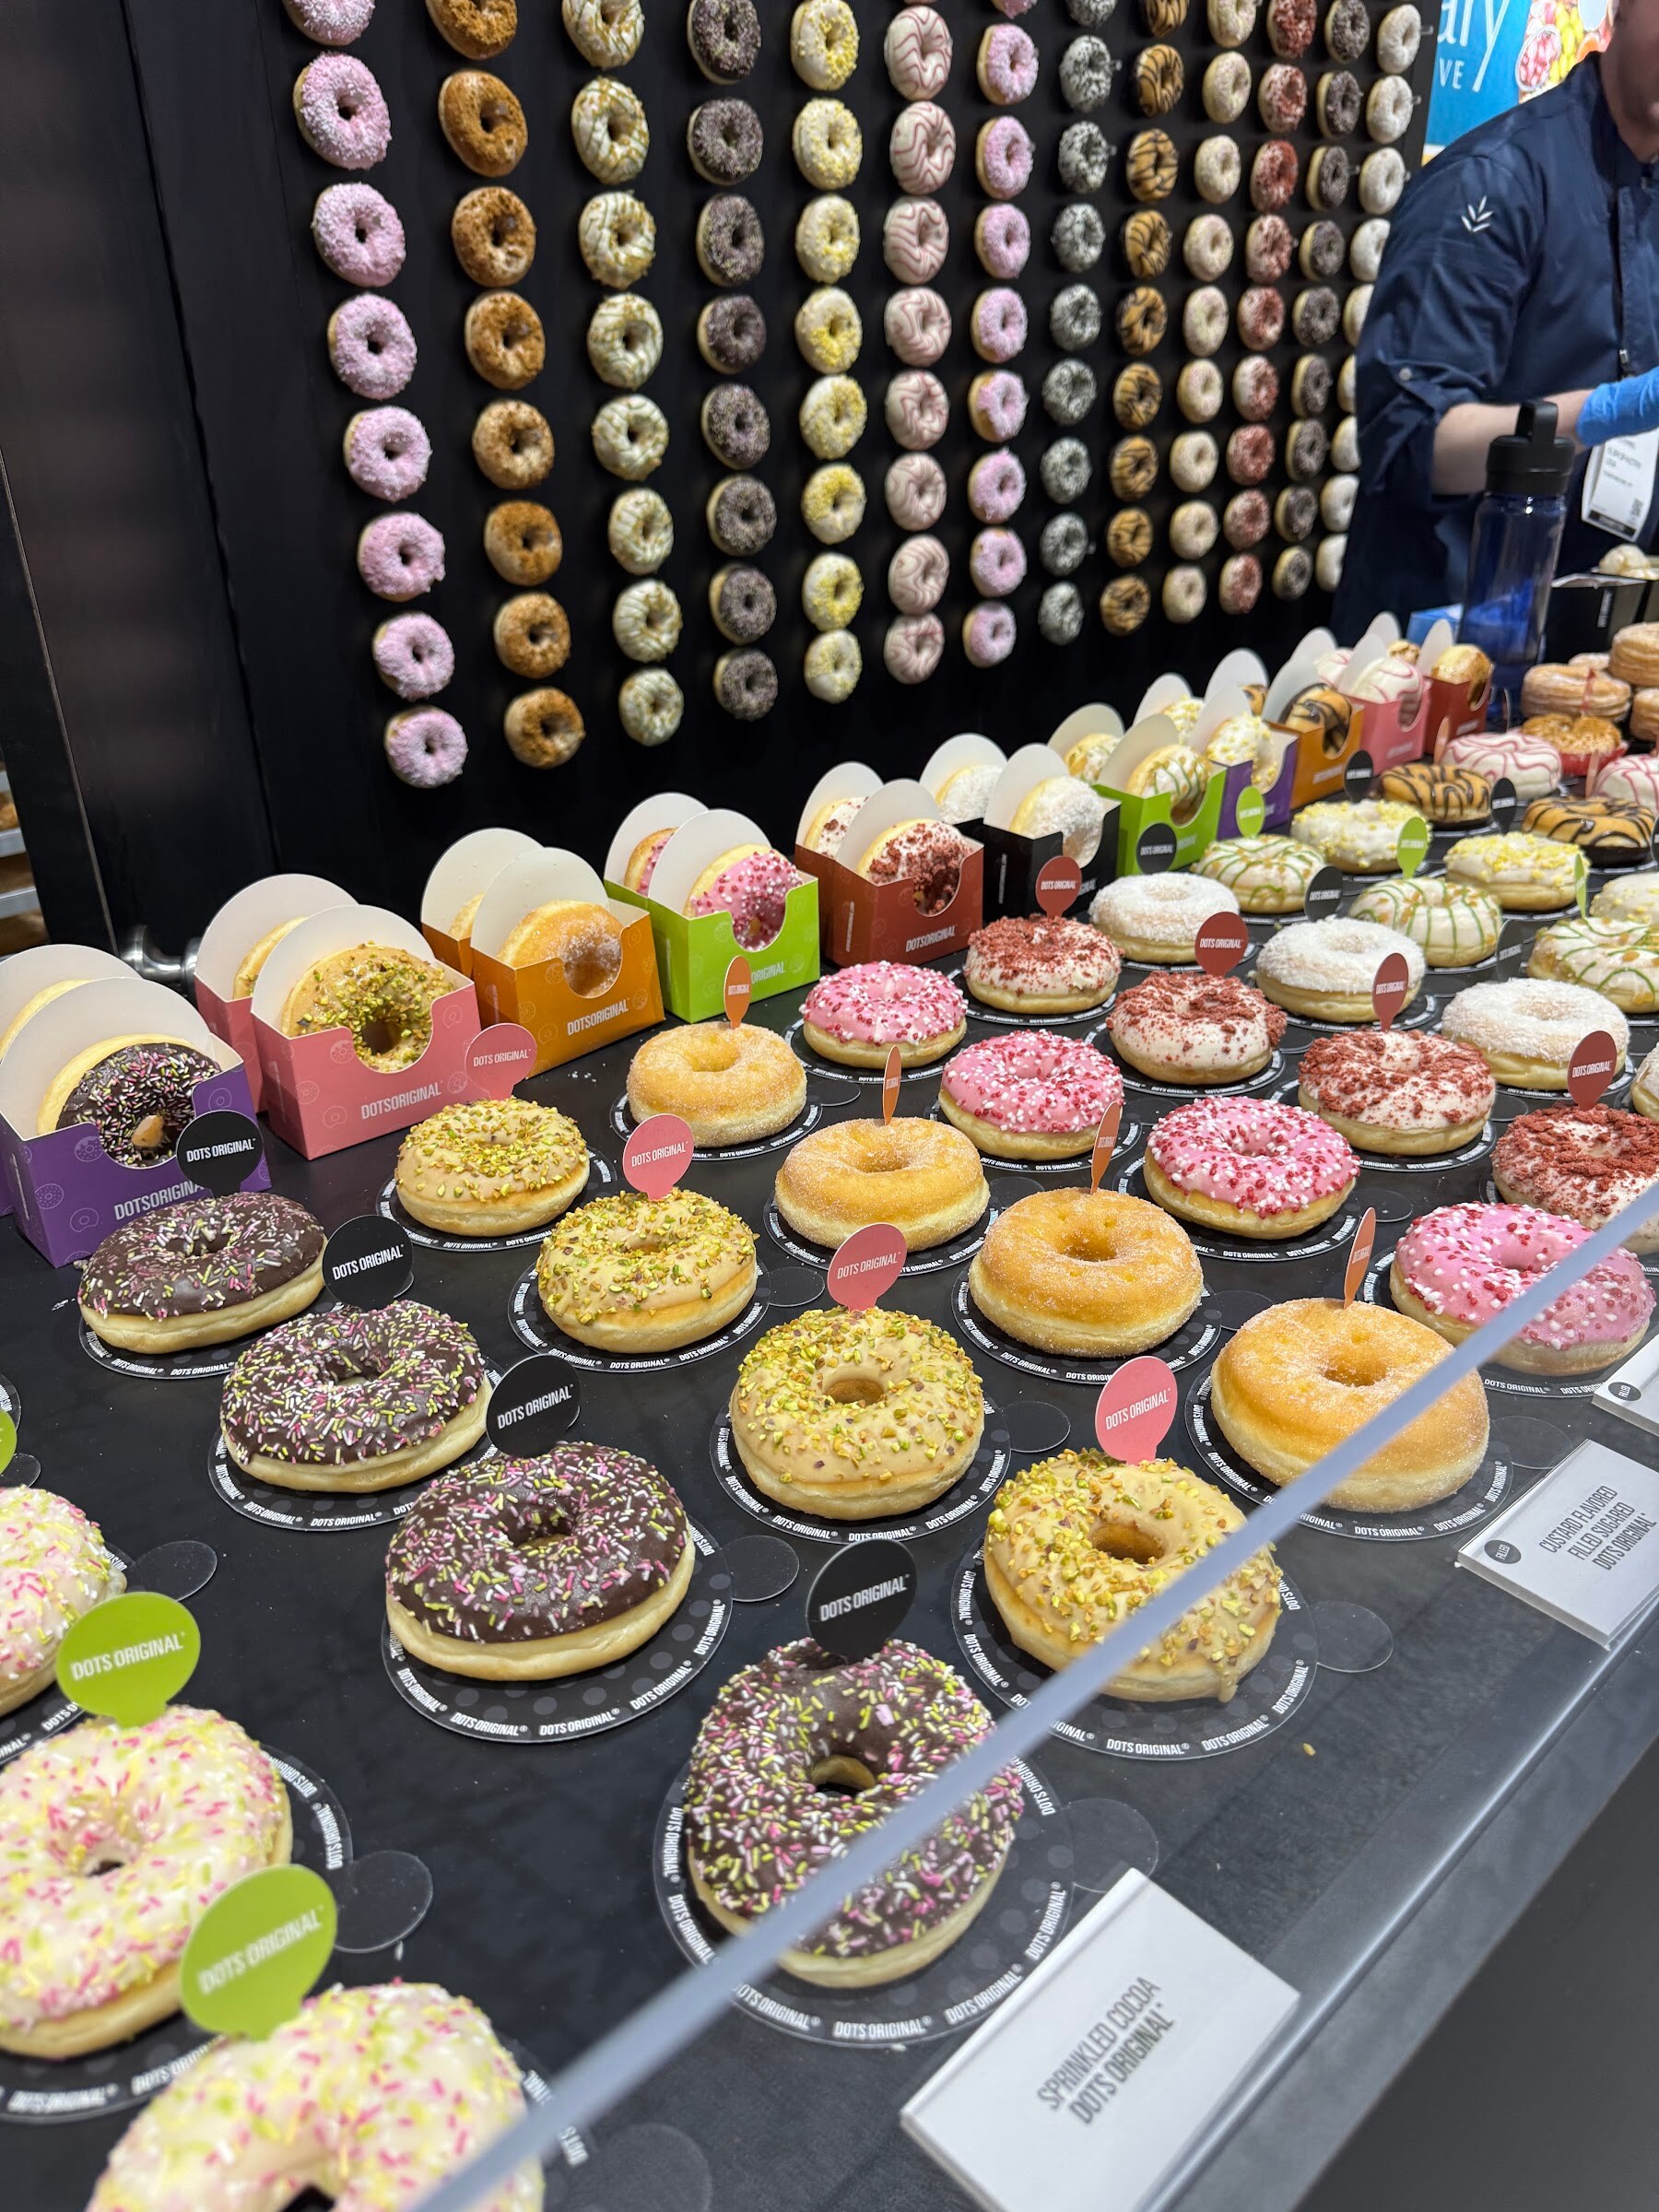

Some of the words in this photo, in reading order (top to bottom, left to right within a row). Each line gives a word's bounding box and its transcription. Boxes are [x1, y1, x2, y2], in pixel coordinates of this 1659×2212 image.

[186, 1148, 211, 1163] DOTS
[212, 1140, 255, 1158] ORIGINAL
[631, 1152, 651, 1167] DOTS
[652, 1144, 686, 1161] ORIGINAL
[114, 1181, 204, 1220] DOTSORIGINA
[524, 1230, 553, 1241] ORIGINA
[333, 1260, 359, 1279] DOTS
[359, 1248, 403, 1271] ORIGINAL
[837, 1262, 859, 1279] DOTS
[860, 1253, 898, 1272] ORIGINAL
[1582, 1382, 1605, 1393] ORIGIN
[497, 1407, 524, 1430] DOTS
[525, 1386, 572, 1415] ORIGINAL
[1106, 1409, 1129, 1430] DOTS
[1130, 1391, 1169, 1418] ORIGINAL
[244, 1501, 265, 1517] DOTS
[261, 1510, 297, 1524] ORIGINAL
[311, 1518, 334, 1526] DOTS
[334, 1514, 376, 1526] ORIGINAL
[1301, 1512, 1336, 1530] RIGINAL
[1355, 1526, 1379, 1536] DOTS
[1379, 1526, 1418, 1536] ORIGINAL
[1539, 1517, 1583, 1553] CUSTARD
[1571, 1485, 1618, 1522] FLAVORED
[1567, 1528, 1603, 1560] FILLED
[1592, 1501, 1635, 1539] SUGARED
[1496, 1544, 1510, 1559] FILLED
[1592, 1544, 1625, 1571] DOTS
[1613, 1518, 1657, 1554] ORIGINAL
[820, 1599, 853, 1622] DOTS
[853, 1581, 908, 1610] ORIGINAL
[694, 1635, 712, 1655] DOTS
[706, 1604, 725, 1641] ORIGINAL
[70, 1654, 112, 1681] DOTS
[113, 1635, 183, 1667] ORIGINAL
[964, 1634, 978, 1653] DOTS
[972, 1651, 999, 1686] ORIGINAL
[397, 1667, 417, 1688] DOTS
[409, 1682, 441, 1712] ORIGINAL
[629, 1689, 658, 1711] DOTS
[653, 1665, 693, 1697] ORIGINAL
[1273, 1694, 1288, 1714] DOTS
[1283, 1664, 1309, 1700] ORIGINAL
[450, 1712, 476, 1729] DOTS
[474, 1721, 519, 1736] ORIGINAL
[539, 1722, 568, 1735] DOTS
[567, 1711, 615, 1733] ORIGINAL
[1054, 1721, 1088, 1742] IGINAL
[1202, 1734, 1229, 1751] DOTS
[1225, 1719, 1268, 1746] ORIGINAL
[1107, 1738, 1134, 1752] DOTS
[1135, 1741, 1183, 1755] ORIGINAL
[270, 1757, 302, 1788] ORIGIN
[316, 1804, 343, 1852] ORIGINAL
[326, 1844, 344, 1870] DOTS
[667, 1894, 688, 1919] DOTS
[679, 1917, 716, 1965] ORIGINAL
[1025, 1932, 1050, 1960] DOTS
[1040, 1888, 1067, 1940] ORIGINAL
[198, 1956, 245, 1995] DOTS
[246, 1910, 322, 1966] ORIGINAL
[945, 2001, 978, 2025] DOTS
[973, 1972, 1023, 2007] ORIGINAL
[833, 2020, 867, 2037] DOTS
[868, 2019, 926, 2039] ORIGINAL
[1037, 2021, 1118, 2111] SPRINKLED
[1106, 1976, 1161, 2030] COCOA
[1068, 2072, 1117, 2124] DOTS
[1103, 2008, 1174, 2084] ORIGINAL
